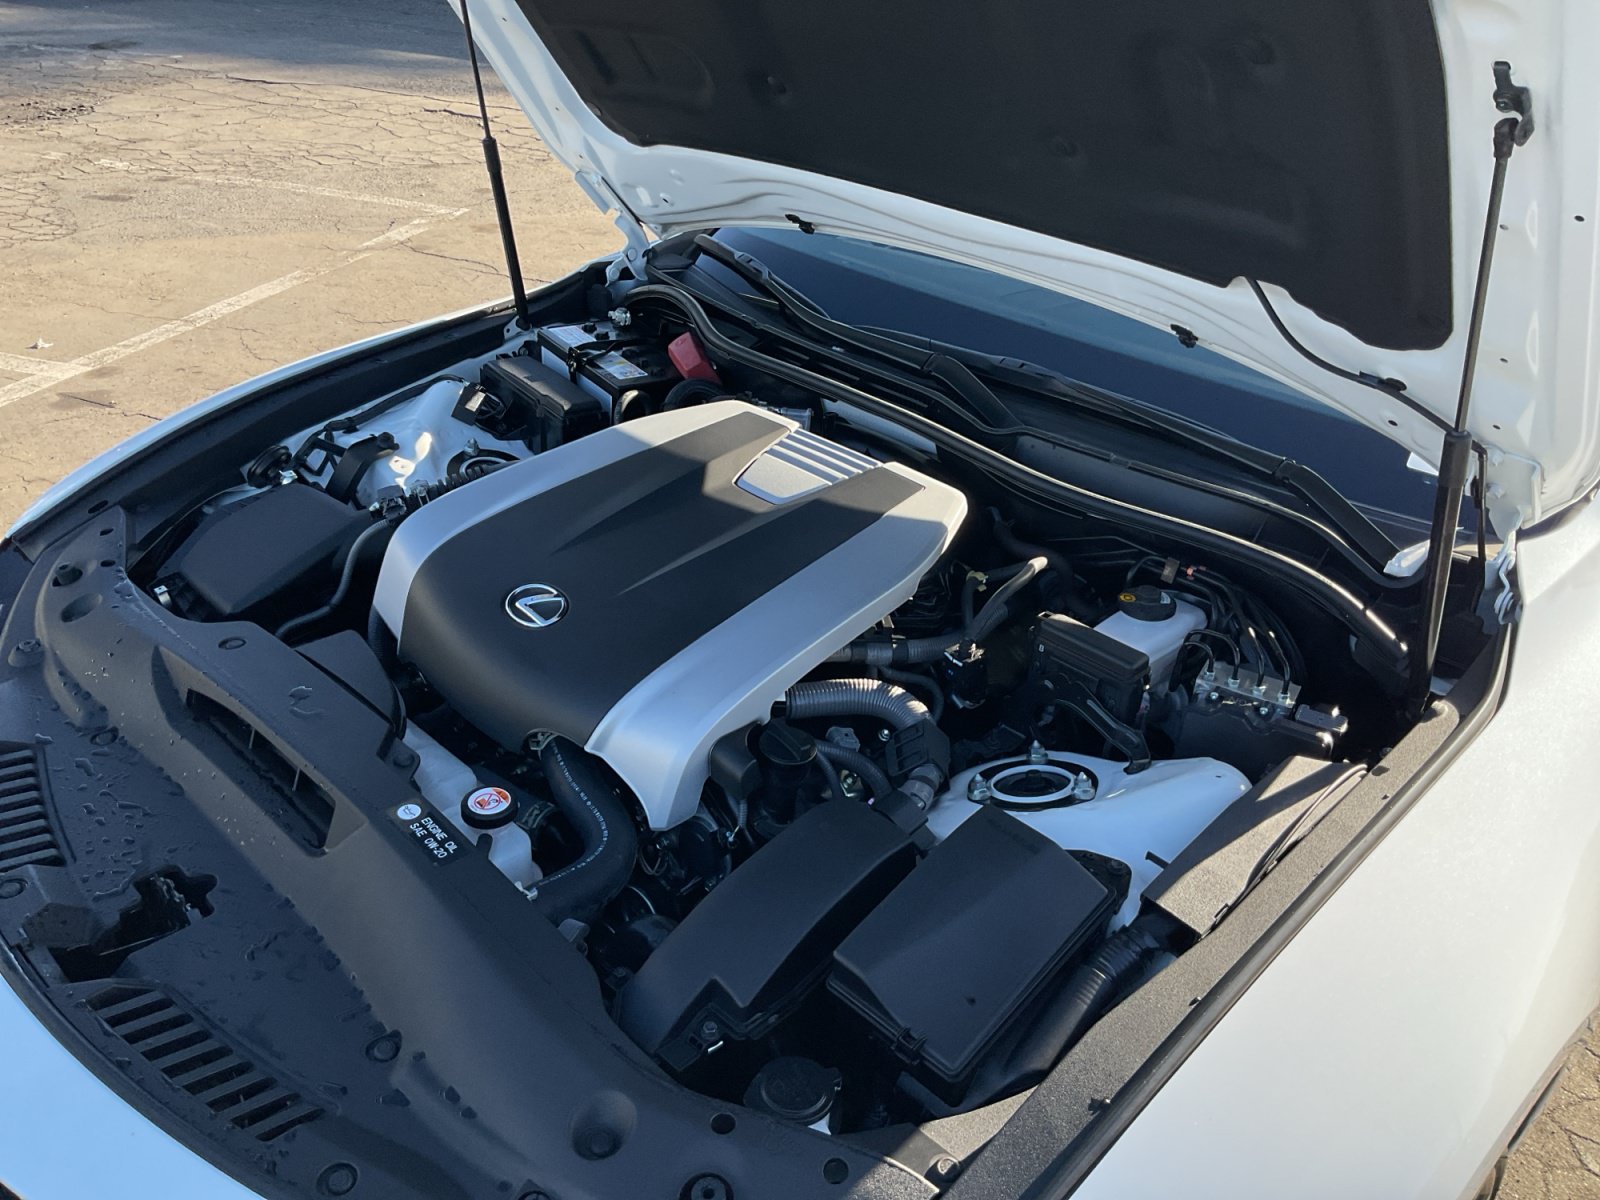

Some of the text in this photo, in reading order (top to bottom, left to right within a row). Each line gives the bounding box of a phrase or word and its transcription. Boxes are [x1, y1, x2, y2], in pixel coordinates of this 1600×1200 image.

[410, 822, 448, 858] SAE 0W-20
[421, 817, 458, 854] ENGINE OIL
